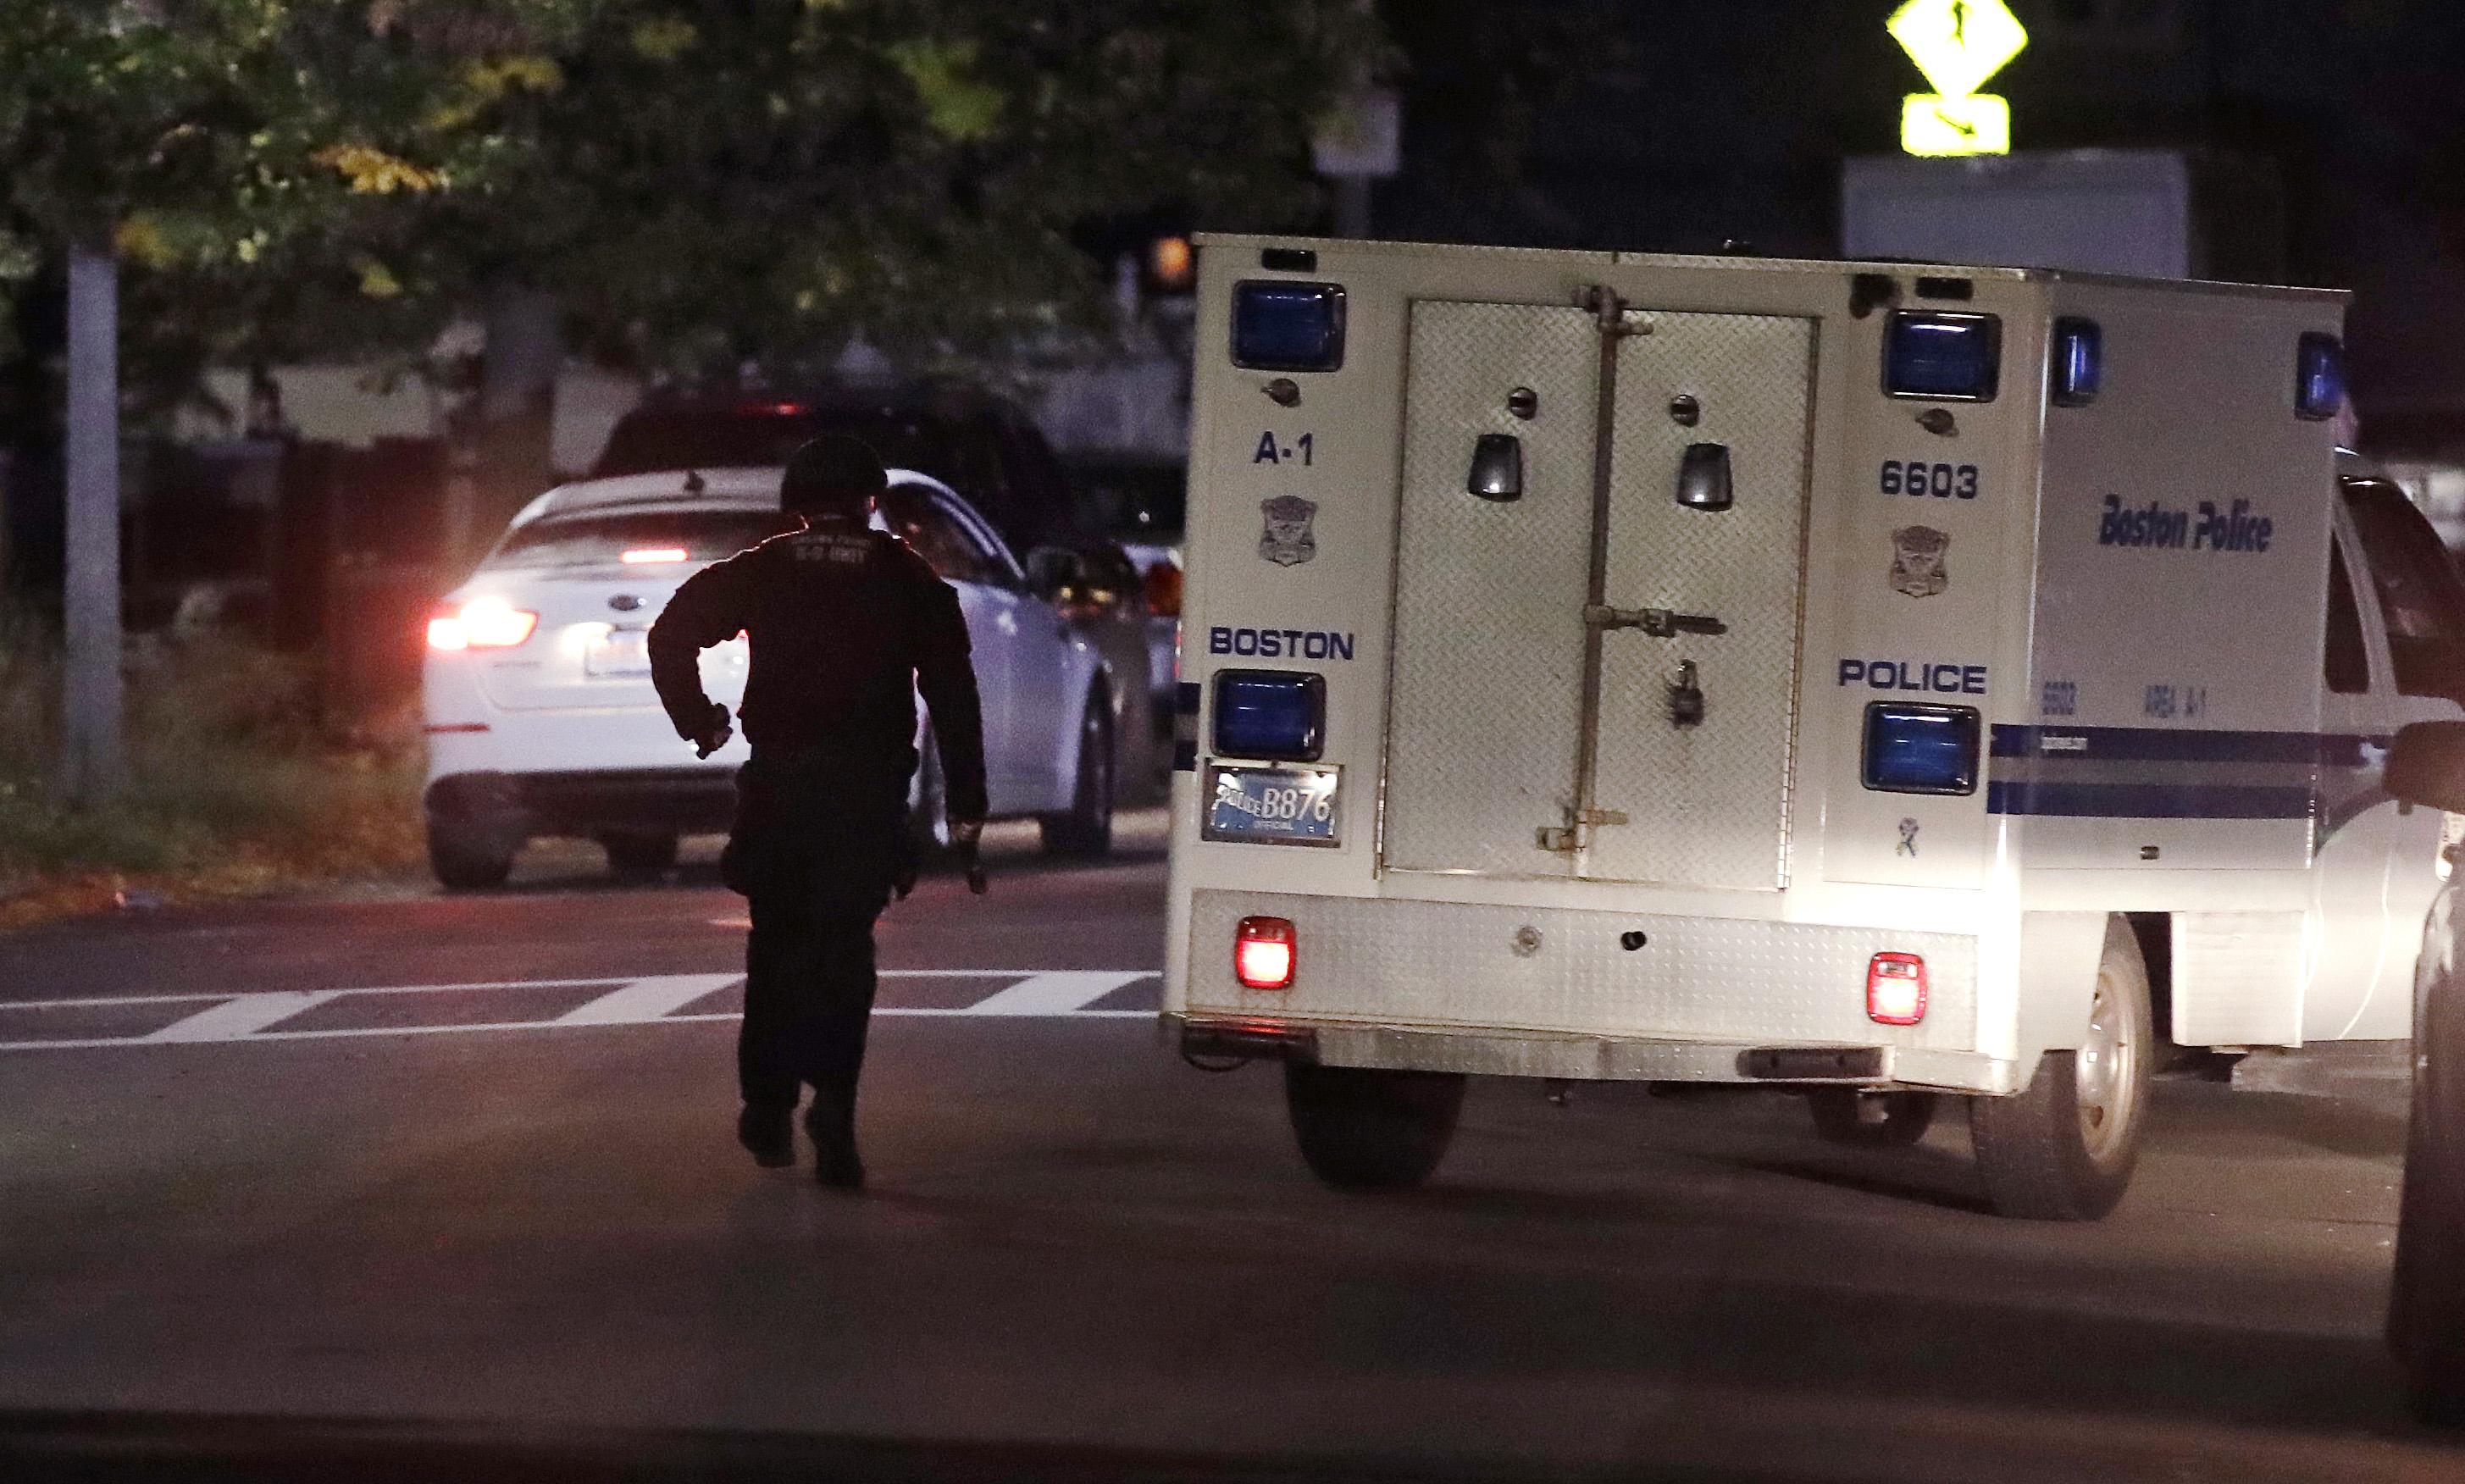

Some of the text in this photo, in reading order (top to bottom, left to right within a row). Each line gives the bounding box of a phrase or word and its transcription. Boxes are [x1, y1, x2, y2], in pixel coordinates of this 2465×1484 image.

[1881, 460, 1979, 500] 6603
[2099, 494, 2273, 552] Boston Police
[1210, 627, 1354, 660] BOSTON
[1839, 659, 1987, 695] POLICE
[1260, 788, 1332, 822] B876
